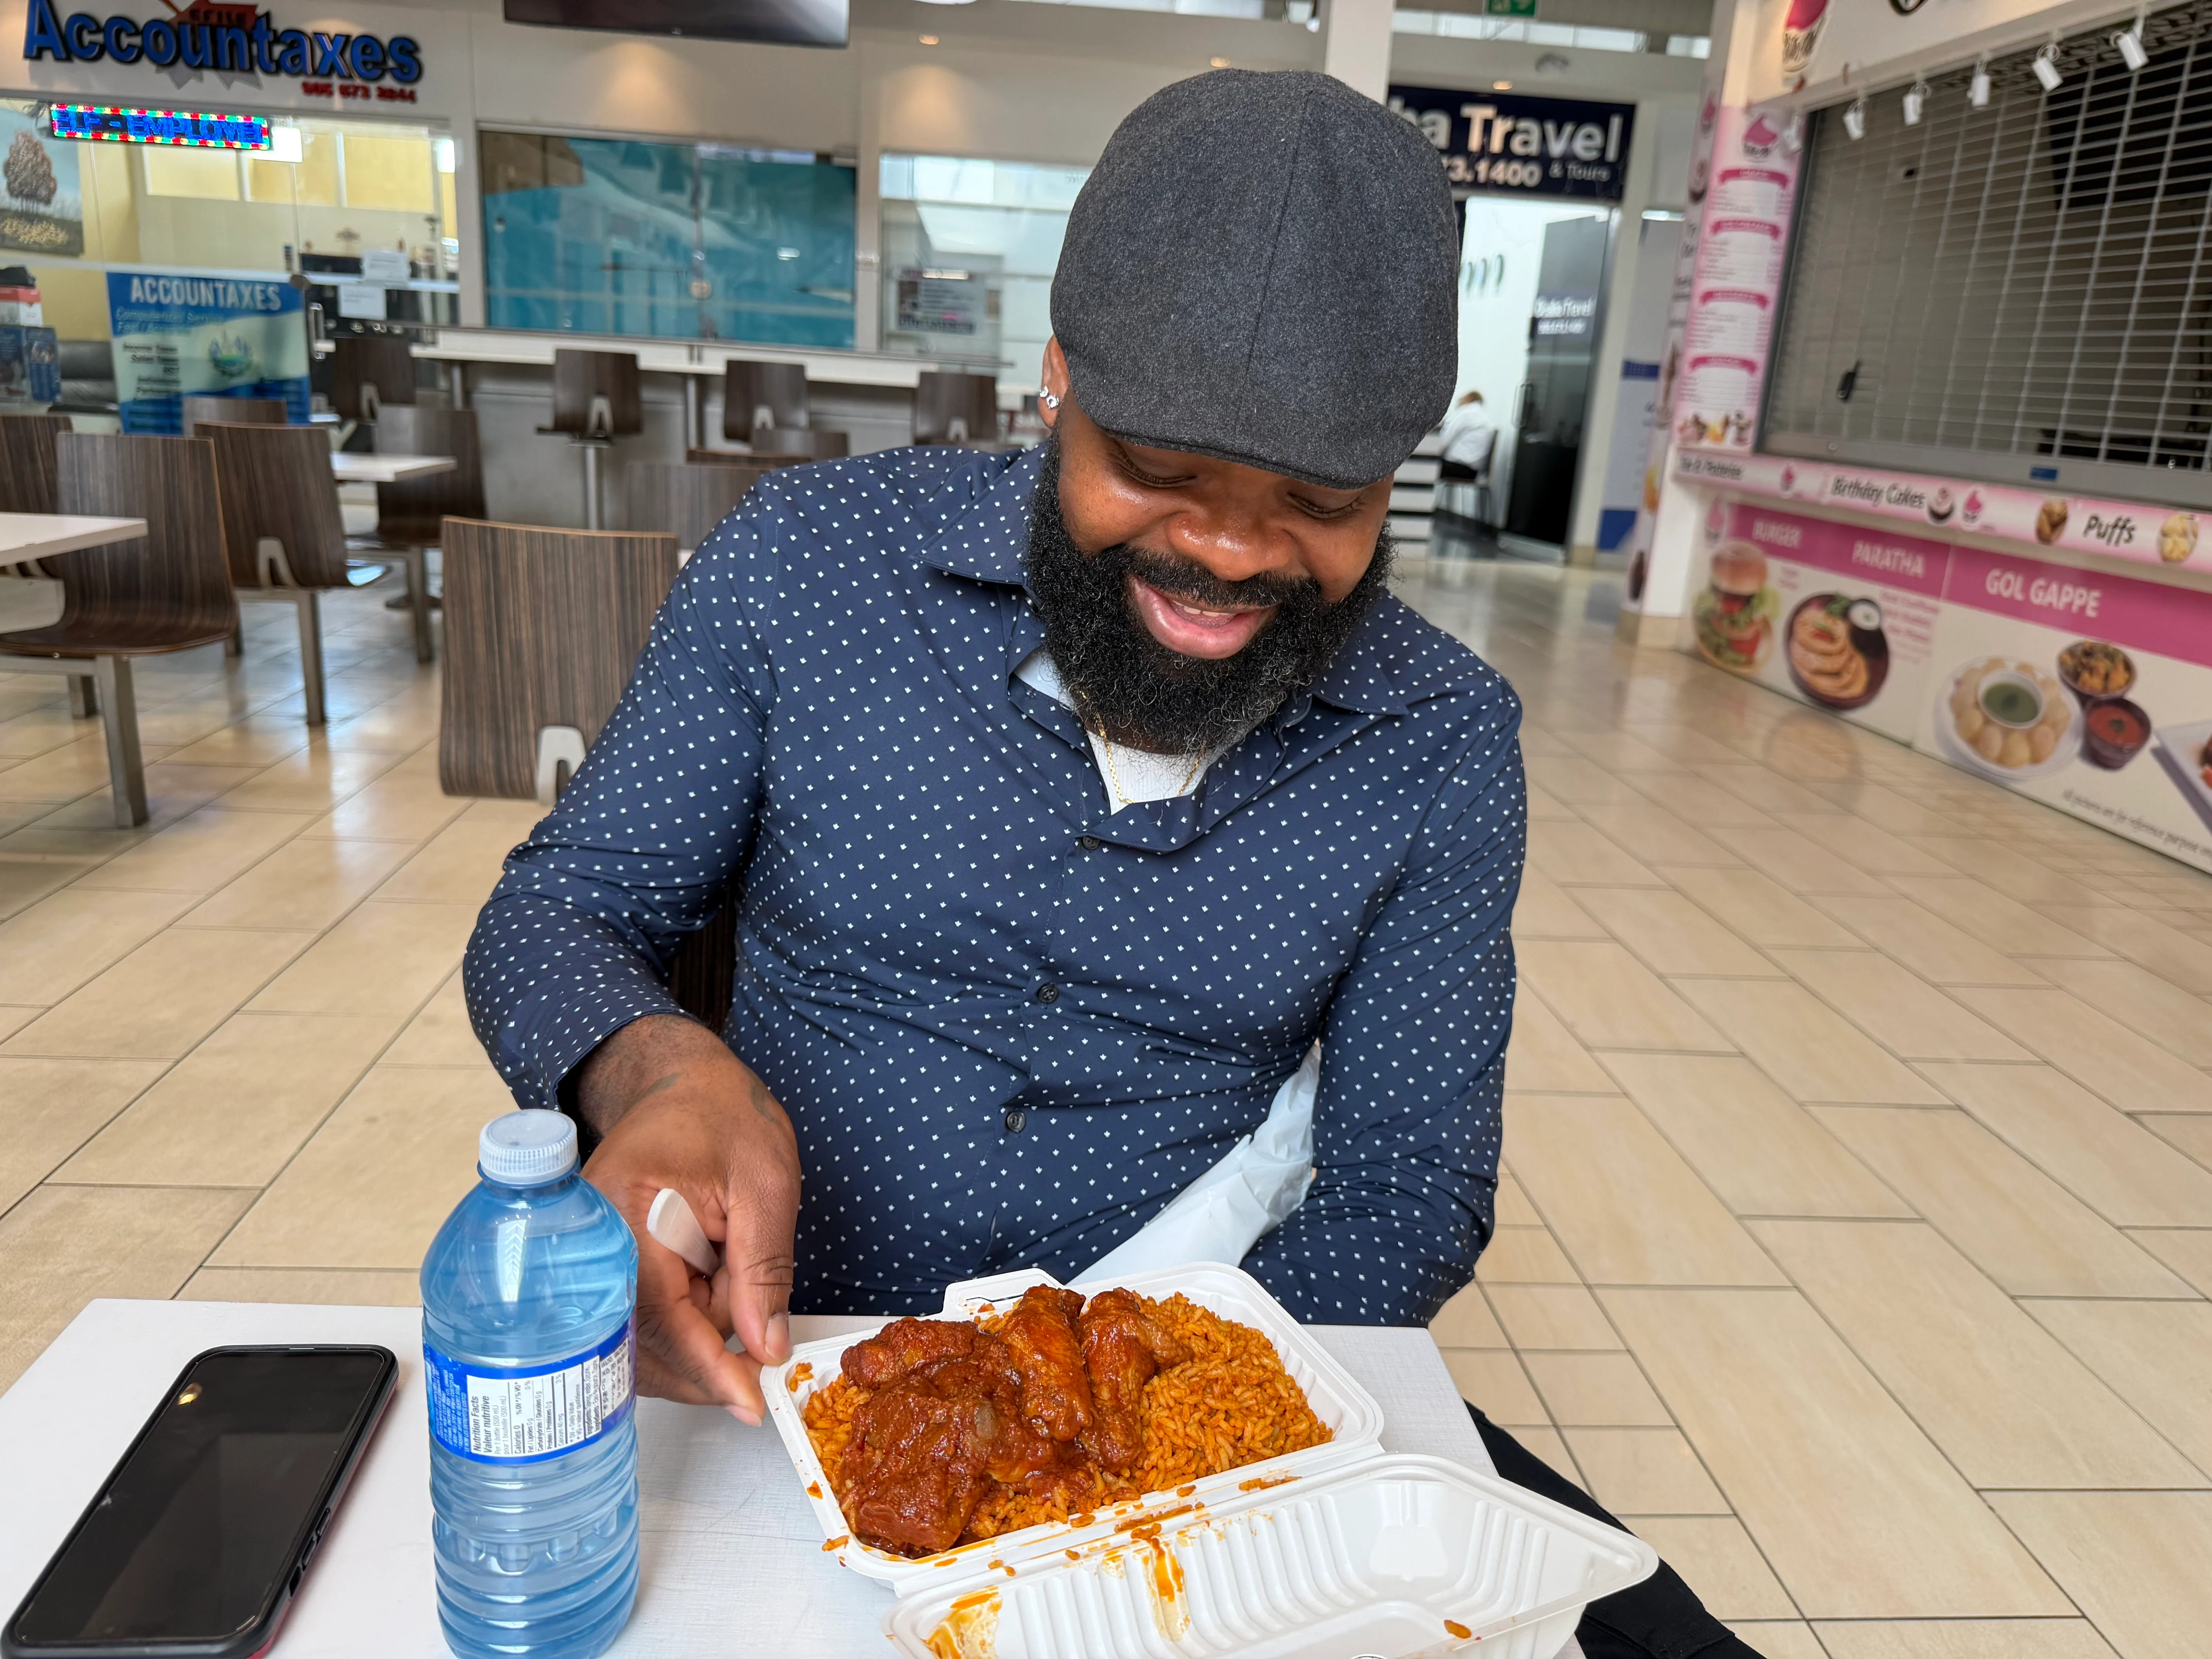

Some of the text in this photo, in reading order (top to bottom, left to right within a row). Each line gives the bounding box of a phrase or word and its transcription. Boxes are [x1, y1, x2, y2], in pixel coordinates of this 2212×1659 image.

[23, 0, 423, 84] Accountaxes
[1461, 103, 1624, 162] Travel
[1567, 159, 1611, 182] Tours
[131, 276, 282, 311] ACCOUNTAXES
[1831, 477, 1926, 510] Birthday Cakes
[1752, 519, 1803, 548] BURGER
[2083, 514, 2135, 547] Puffs
[1852, 540, 1926, 579] PARATHA
[1985, 568, 2102, 618] GOL GAPPE
[471, 1396, 481, 1452] Nutrition Facts
[481, 1396, 492, 1453] Valeur nutritive
